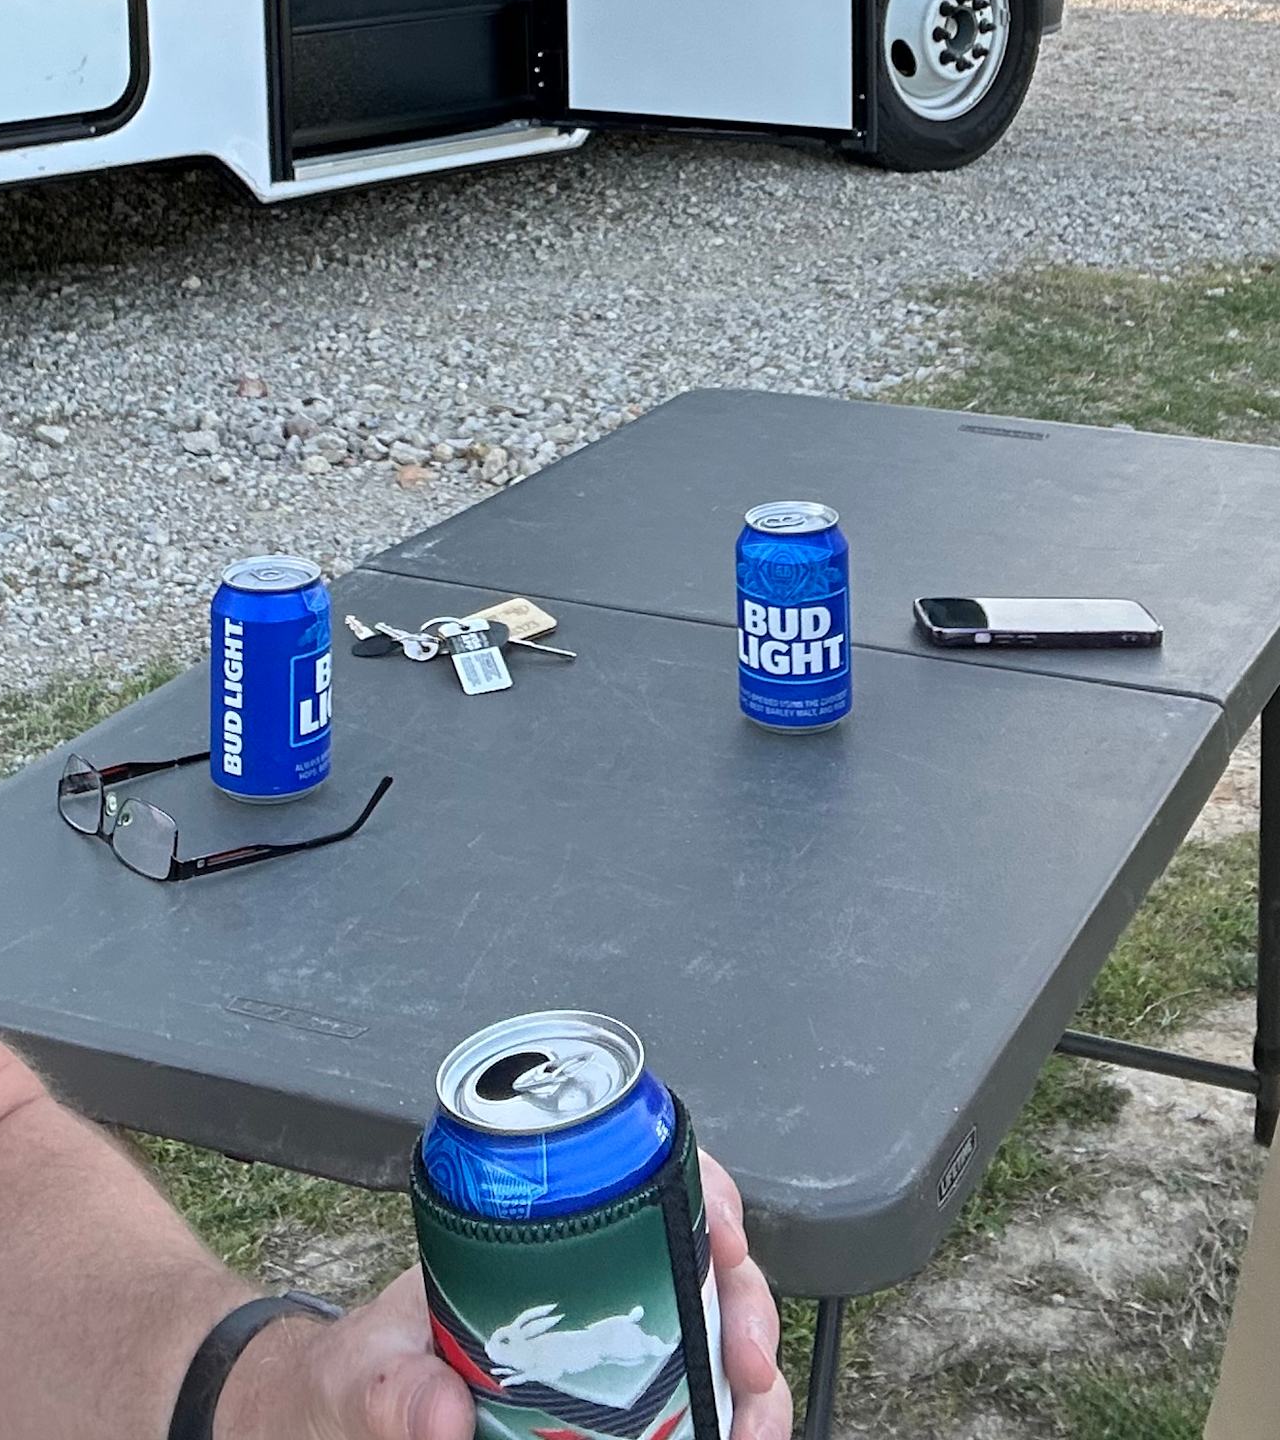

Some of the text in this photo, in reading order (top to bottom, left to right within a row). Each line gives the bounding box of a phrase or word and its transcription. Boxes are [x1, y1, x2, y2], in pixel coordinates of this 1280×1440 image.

[744, 599, 831, 641] BUD
[738, 628, 844, 675] LIGHT
[224, 618, 243, 776] BUD LIGHT
